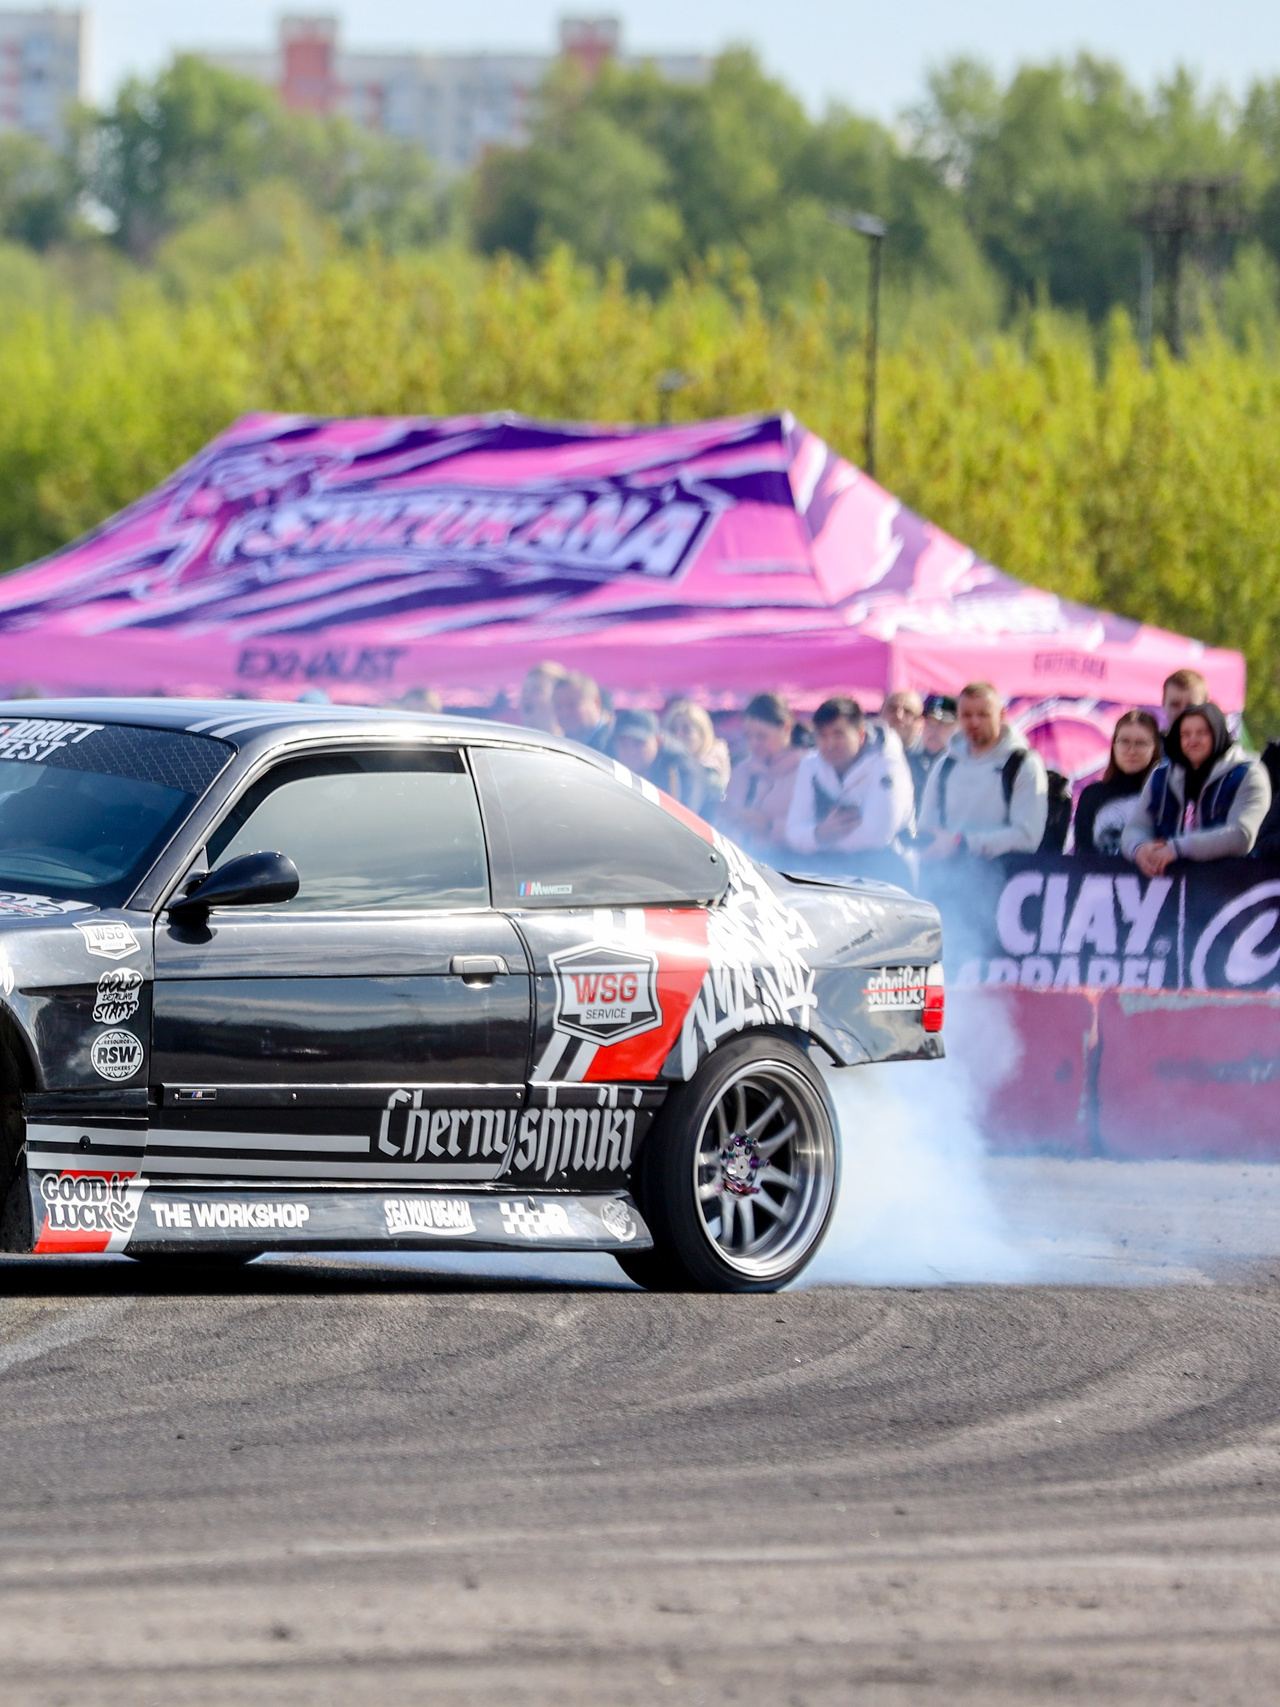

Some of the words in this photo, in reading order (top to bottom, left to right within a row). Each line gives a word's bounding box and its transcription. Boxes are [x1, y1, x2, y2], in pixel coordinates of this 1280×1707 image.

[18, 719, 105, 743] DRIFT
[91, 926, 124, 940] WSG
[98, 971, 143, 993] GOLD
[570, 973, 638, 1005] WSG
[586, 1008, 627, 1020] SERVICE
[97, 1046, 137, 1064] RSW
[378, 1088, 643, 1182] Chernyshniki
[42, 1176, 107, 1202] GOOD
[47, 1203, 113, 1229] LUCK
[151, 1203, 192, 1228] THE
[192, 1203, 310, 1228] WORKSHOP
